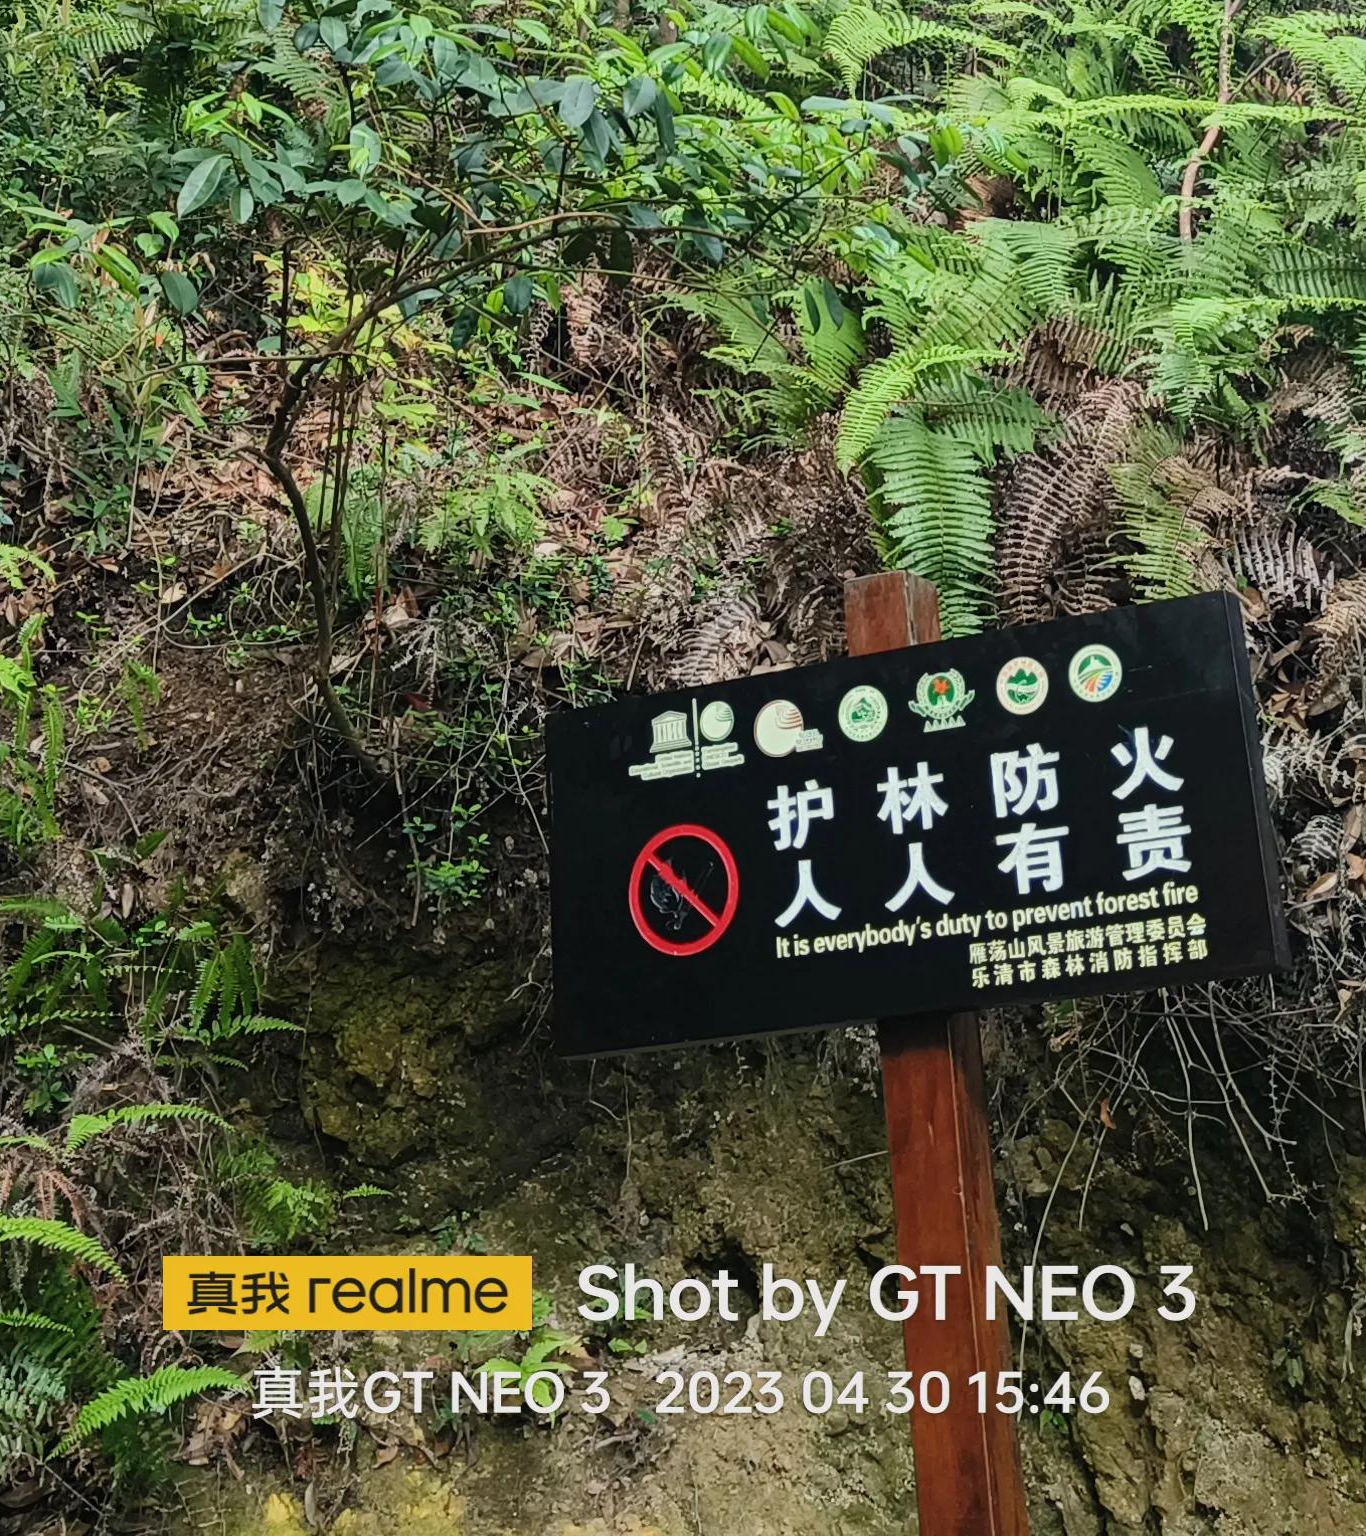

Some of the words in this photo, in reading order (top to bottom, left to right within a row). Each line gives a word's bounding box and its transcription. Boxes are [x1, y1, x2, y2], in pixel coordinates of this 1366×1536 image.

[767, 726, 1185, 851] 护林防火
[774, 803, 1192, 928] 人人有责
[775, 936, 791, 959] It
[793, 933, 811, 957] is
[813, 915, 933, 954] everybody's
[935, 912, 982, 938] duty
[984, 909, 1009, 931] to
[1011, 895, 1094, 933] prevent
[1095, 886, 1161, 916] forest
[1161, 881, 1200, 907] fire
[968, 912, 1208, 965] 雁荡山风景旅游管理委员会
[971, 938, 1209, 989] 乐清市森林消防指挥部
